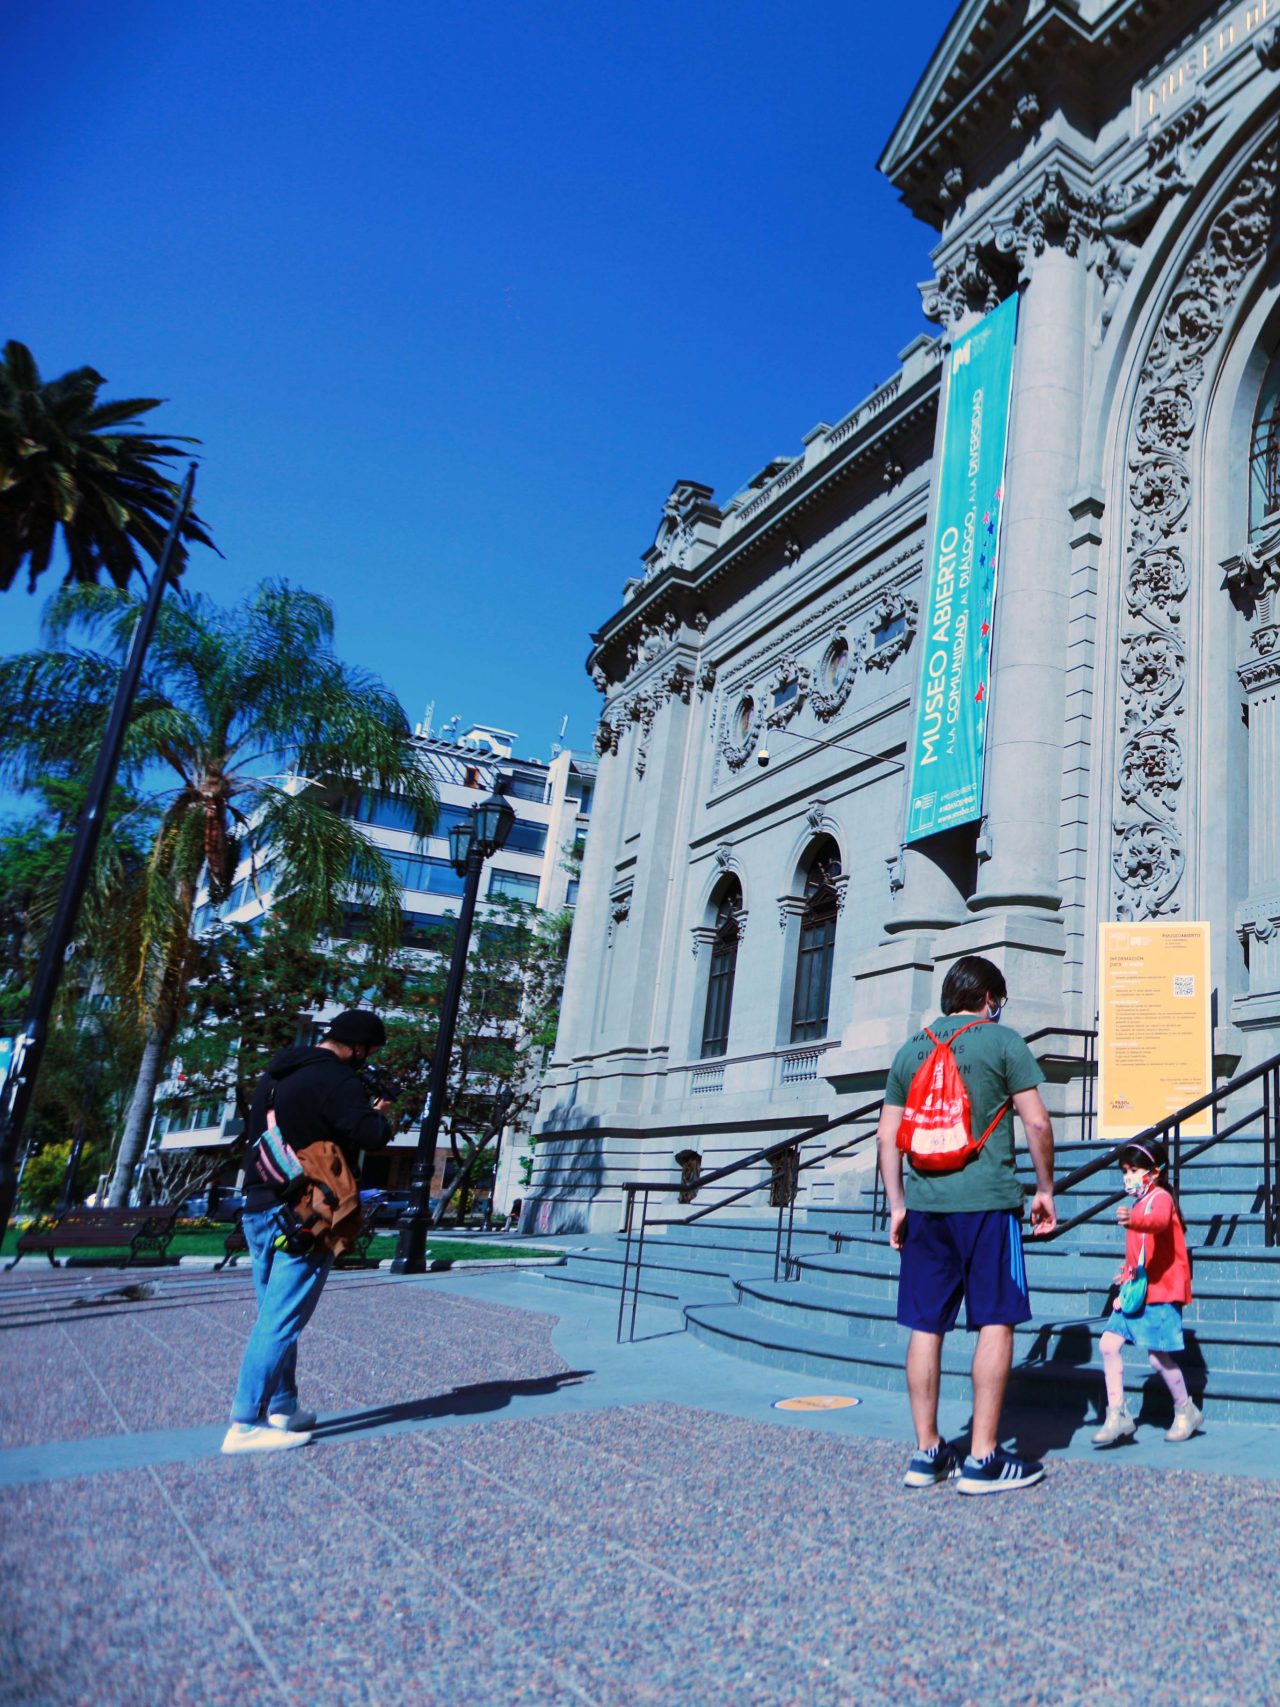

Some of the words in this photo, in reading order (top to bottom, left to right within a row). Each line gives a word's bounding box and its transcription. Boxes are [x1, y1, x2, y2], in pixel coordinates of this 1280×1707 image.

[968, 387, 982, 478] DIVERSIDAD
[932, 526, 959, 642] ABIERTO
[920, 650, 947, 766] MUSEO
[912, 1026, 983, 1043] MANHATAN
[917, 1044, 965, 1061] QUNS
